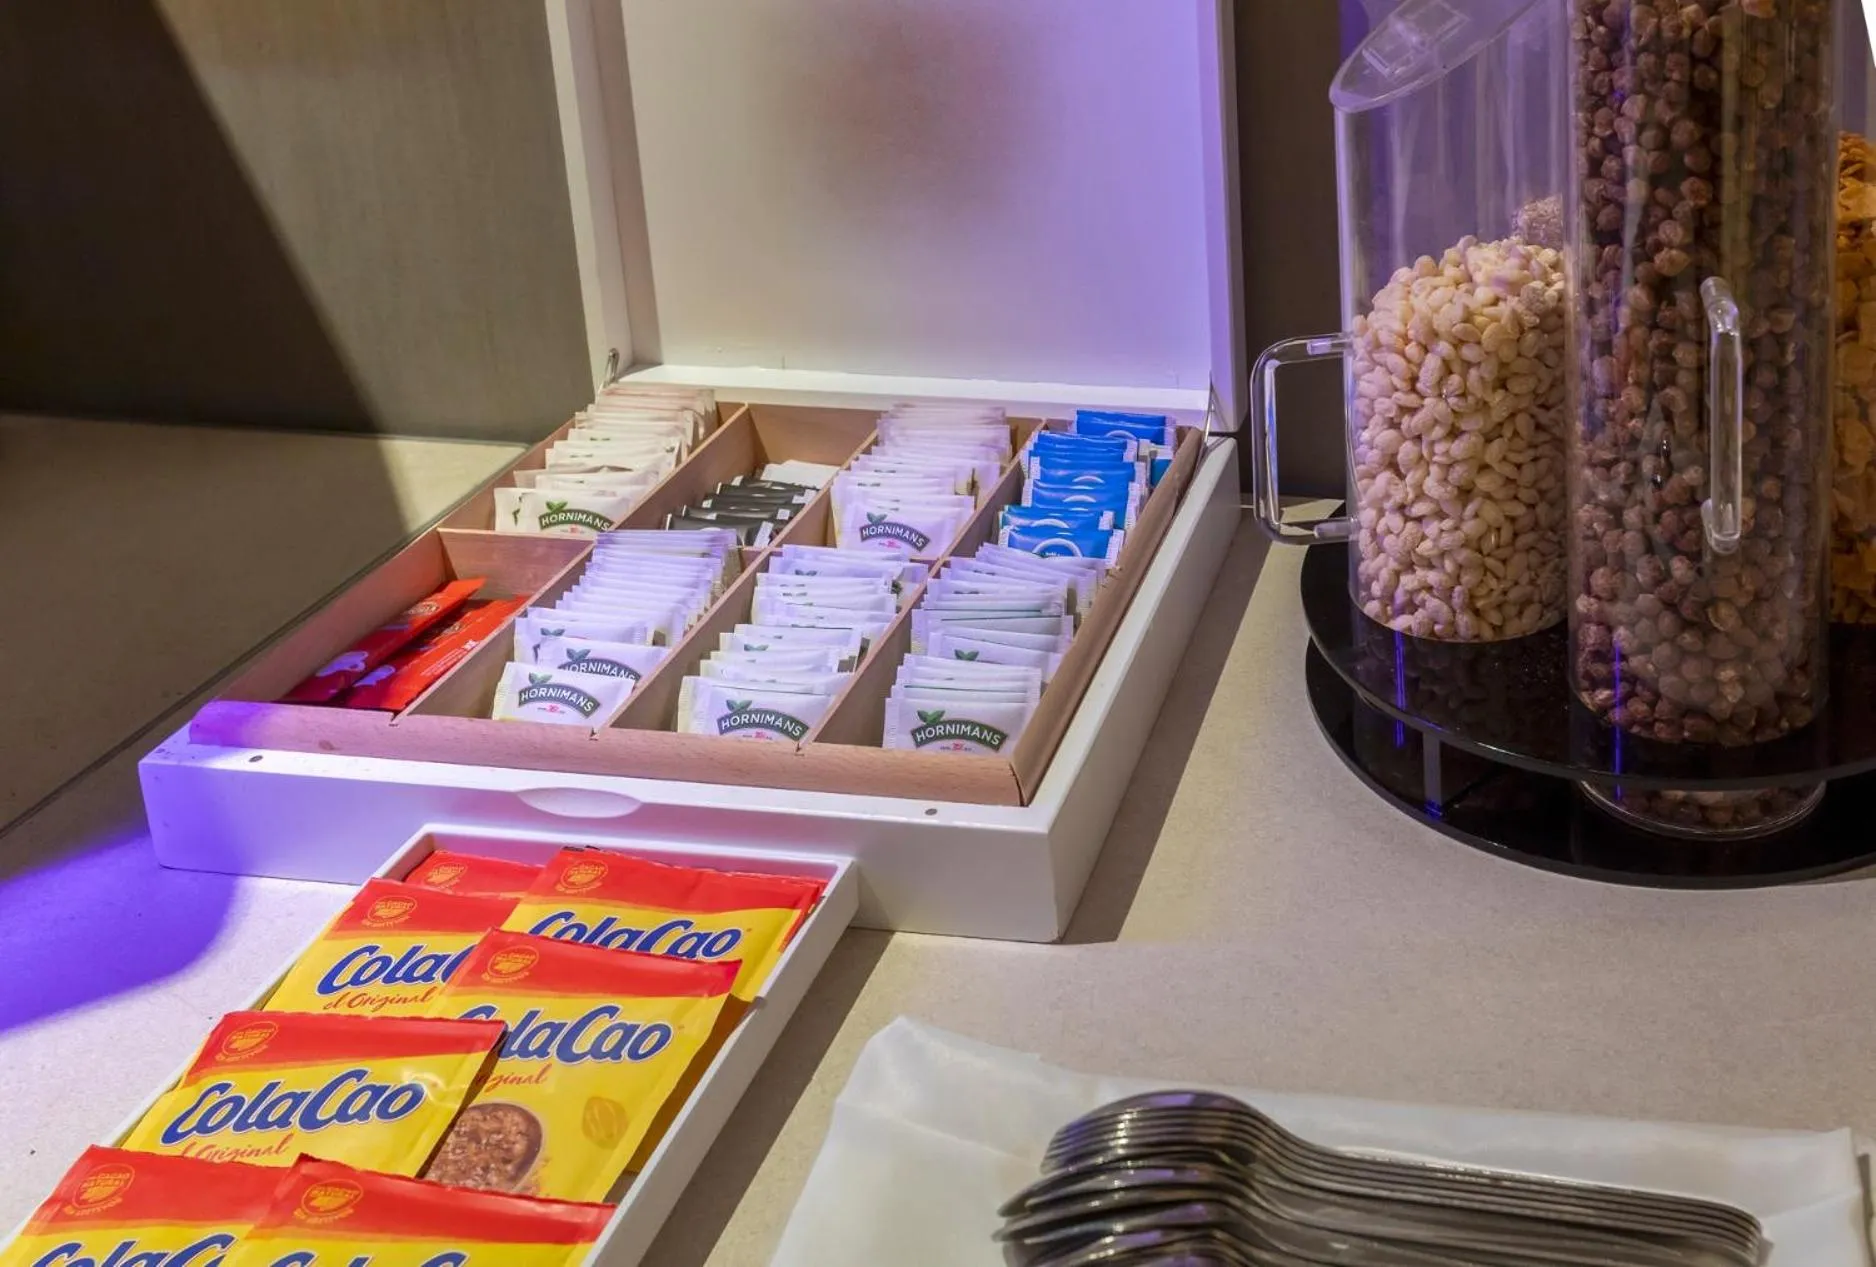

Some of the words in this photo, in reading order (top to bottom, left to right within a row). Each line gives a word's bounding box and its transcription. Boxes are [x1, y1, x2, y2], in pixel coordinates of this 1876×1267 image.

[541, 511, 611, 531] HORNIMANS
[861, 525, 926, 548] HORNIMANS
[520, 686, 595, 713] HORNIMANS
[721, 713, 804, 737] HORNIMANS
[915, 723, 1001, 746] HORNIMANS
[347, 986, 438, 1013] Original
[159, 1068, 427, 1146] ColaCao
